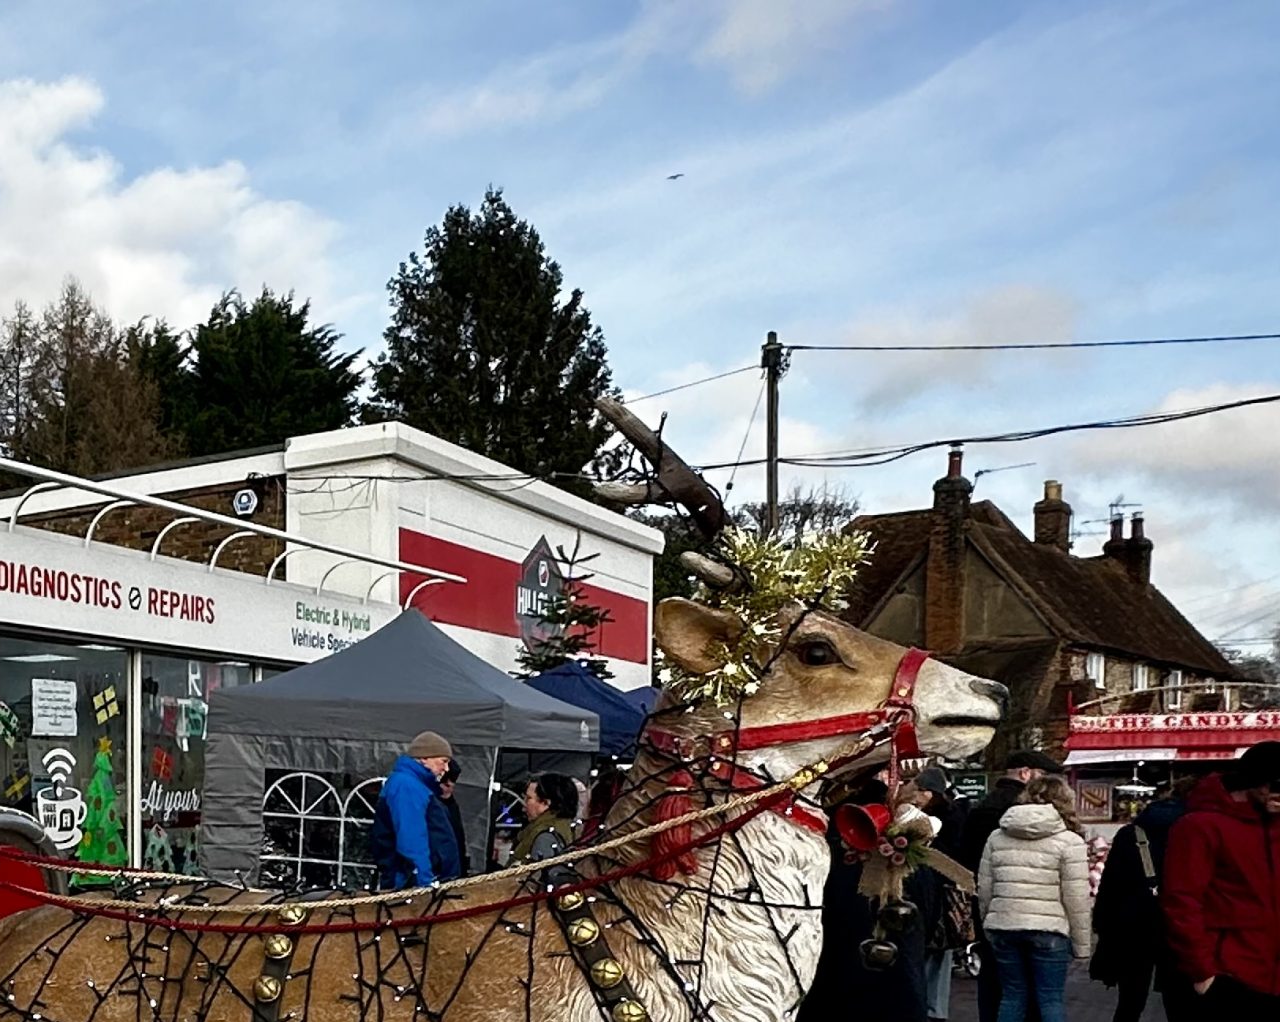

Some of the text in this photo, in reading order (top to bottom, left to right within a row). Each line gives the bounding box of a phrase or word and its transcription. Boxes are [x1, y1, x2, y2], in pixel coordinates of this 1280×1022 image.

[148, 587, 216, 624] REPAIRS
[296, 601, 371, 633] Electric & Hybrid
[291, 626, 326, 650] Vehicle
[1106, 716, 1154, 729] THE
[1163, 713, 1249, 728] CANDY
[141, 780, 200, 822] At your
